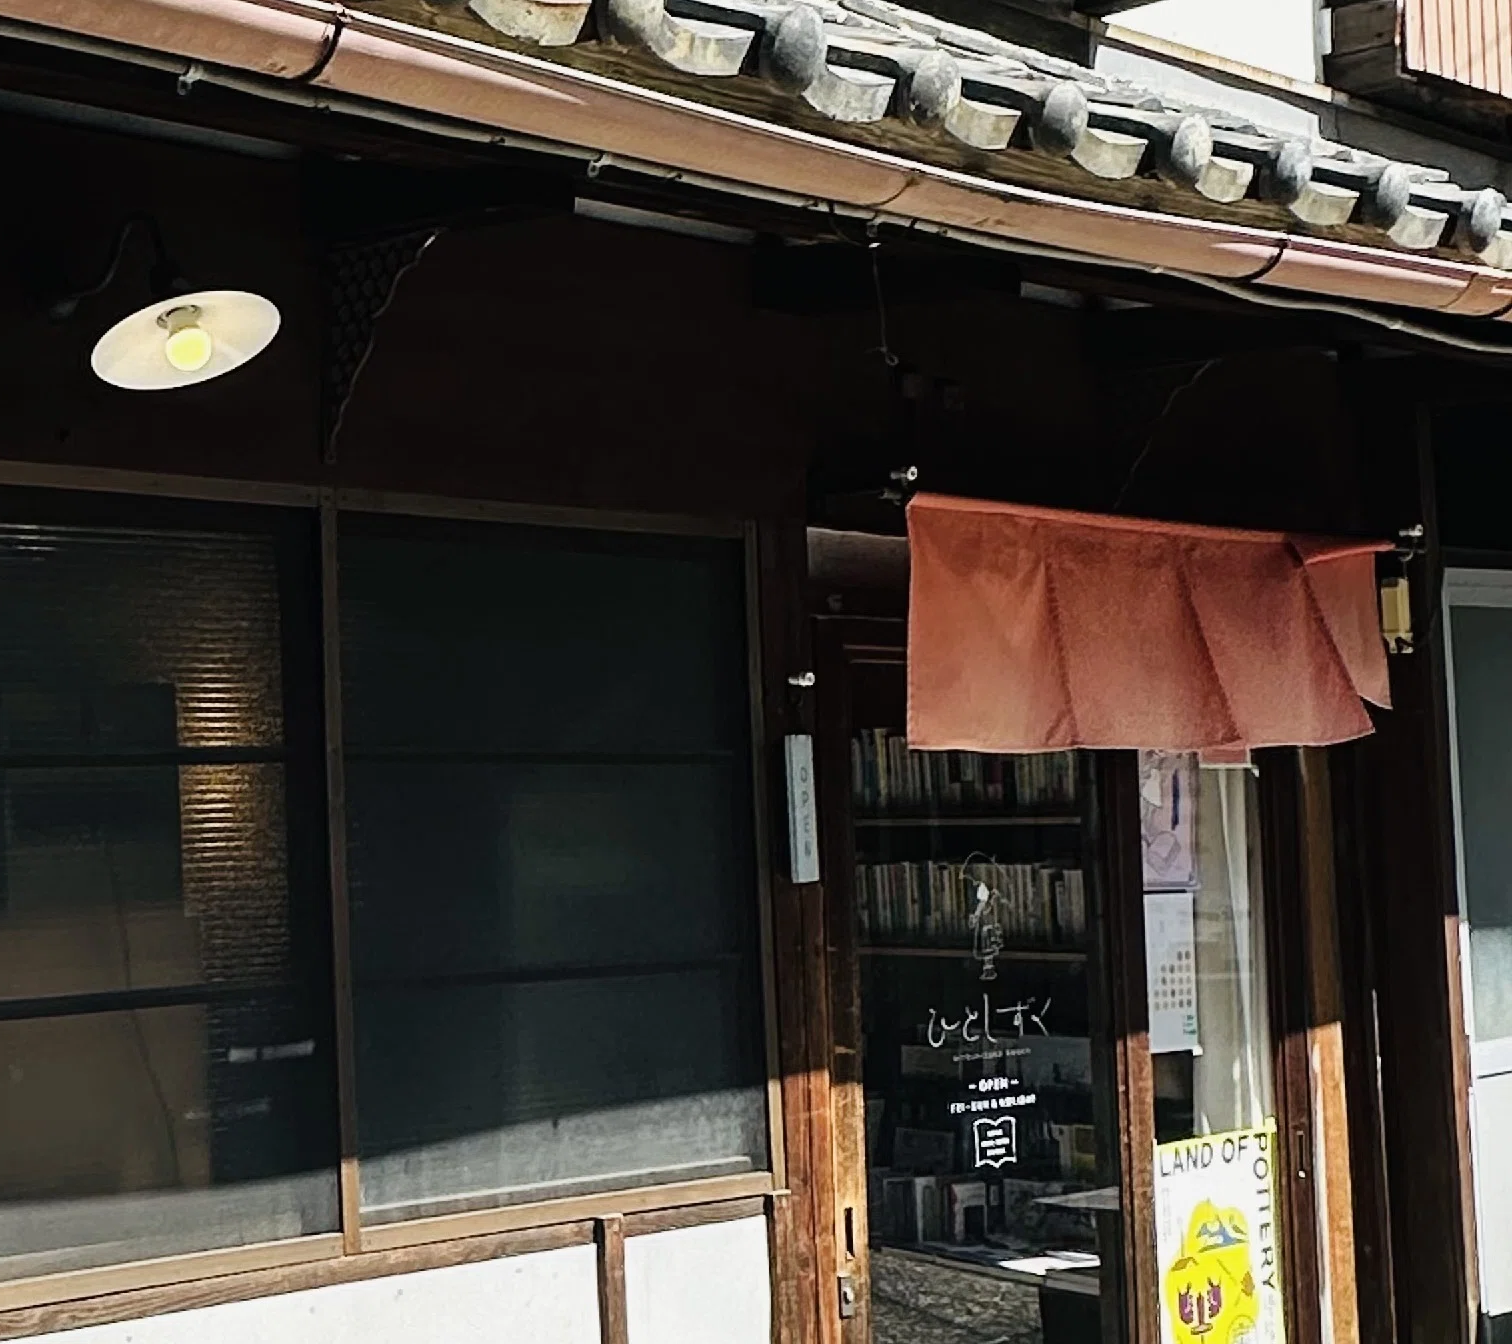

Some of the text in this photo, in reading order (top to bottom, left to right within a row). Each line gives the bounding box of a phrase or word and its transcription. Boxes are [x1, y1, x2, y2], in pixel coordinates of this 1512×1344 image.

[927, 992, 1053, 1048] ひとしずく
[1159, 1132, 1275, 1290] LAND OF POTTERY
